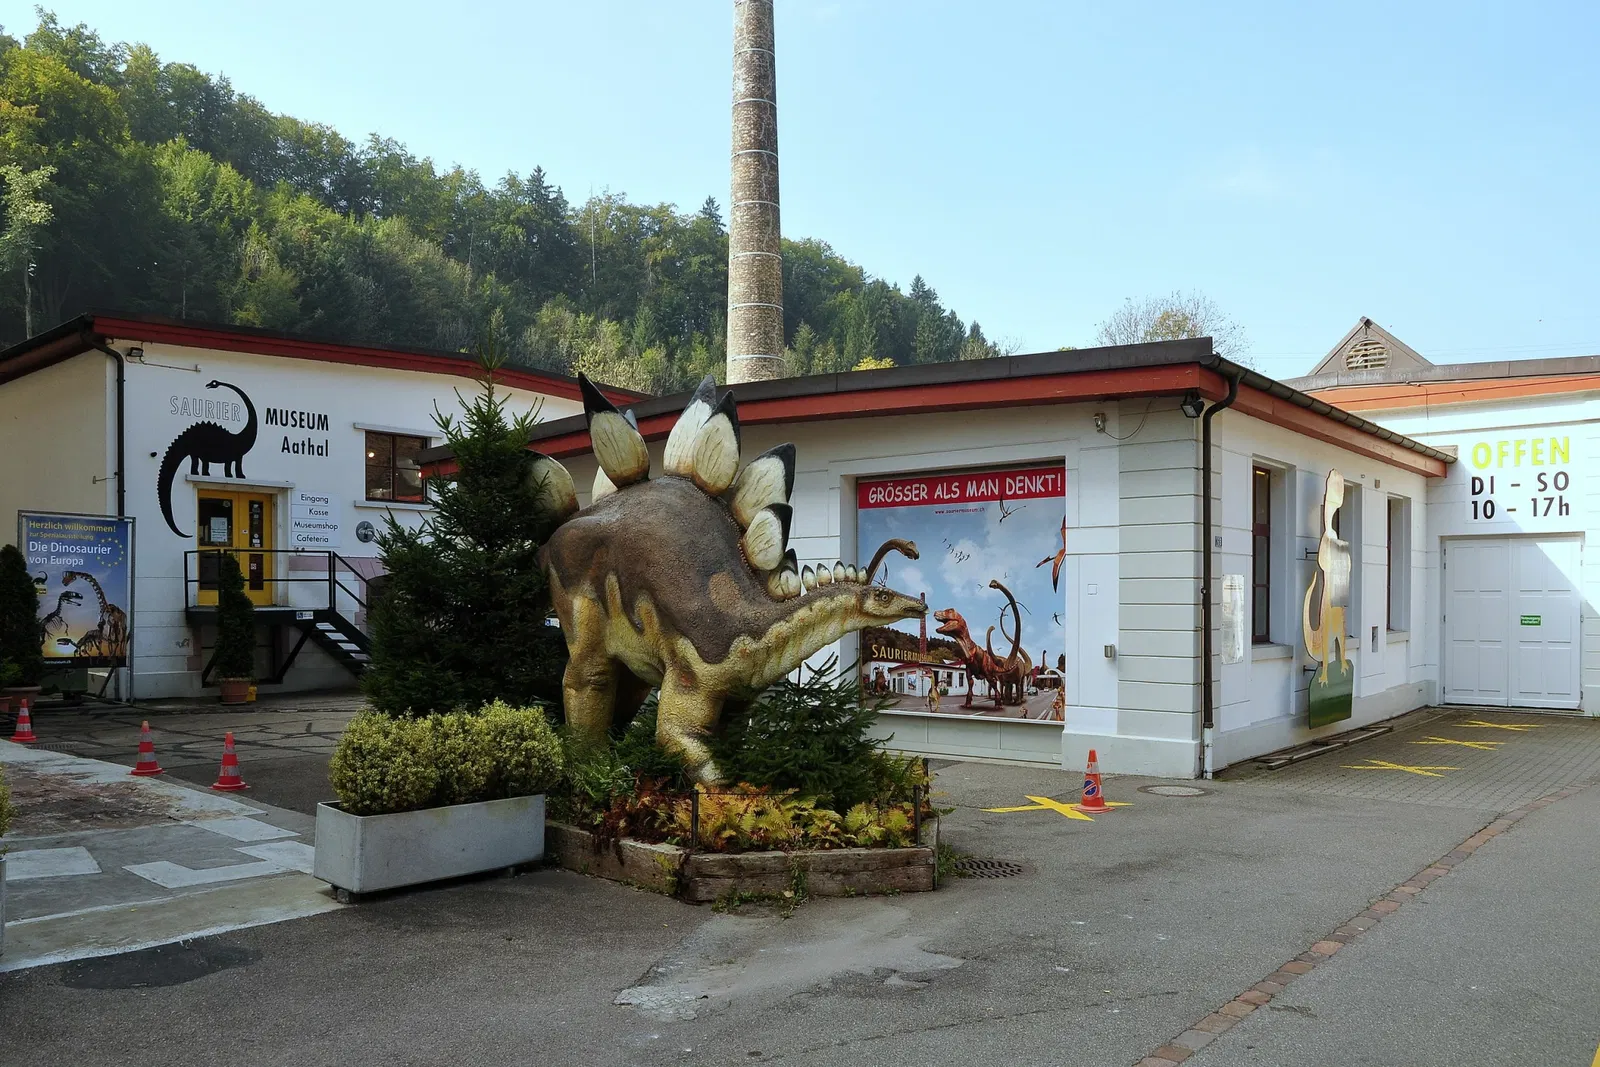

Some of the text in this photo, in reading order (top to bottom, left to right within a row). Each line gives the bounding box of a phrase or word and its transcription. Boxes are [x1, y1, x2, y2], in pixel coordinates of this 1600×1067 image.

[170, 395, 329, 432] SAURIER MUSEUM
[281, 436, 329, 457] Aathal
[1471, 436, 1570, 470] OFFEN
[868, 472, 1061, 504] GRÖSSER ALS MAN DENKT!
[1471, 475, 1495, 496] DI
[1537, 471, 1570, 493] SO
[301, 493, 329, 505] Eingang
[308, 507, 329, 516] Kasse
[1471, 499, 1496, 520] 10
[1530, 495, 1570, 517] 17h
[29, 520, 116, 533] Herzlich willkommen!
[293, 521, 339, 531] Museumshop
[296, 534, 329, 543] Cafeteria
[29, 541, 112, 555] Die Dinosaurier
[29, 556, 84, 567] von Europa
